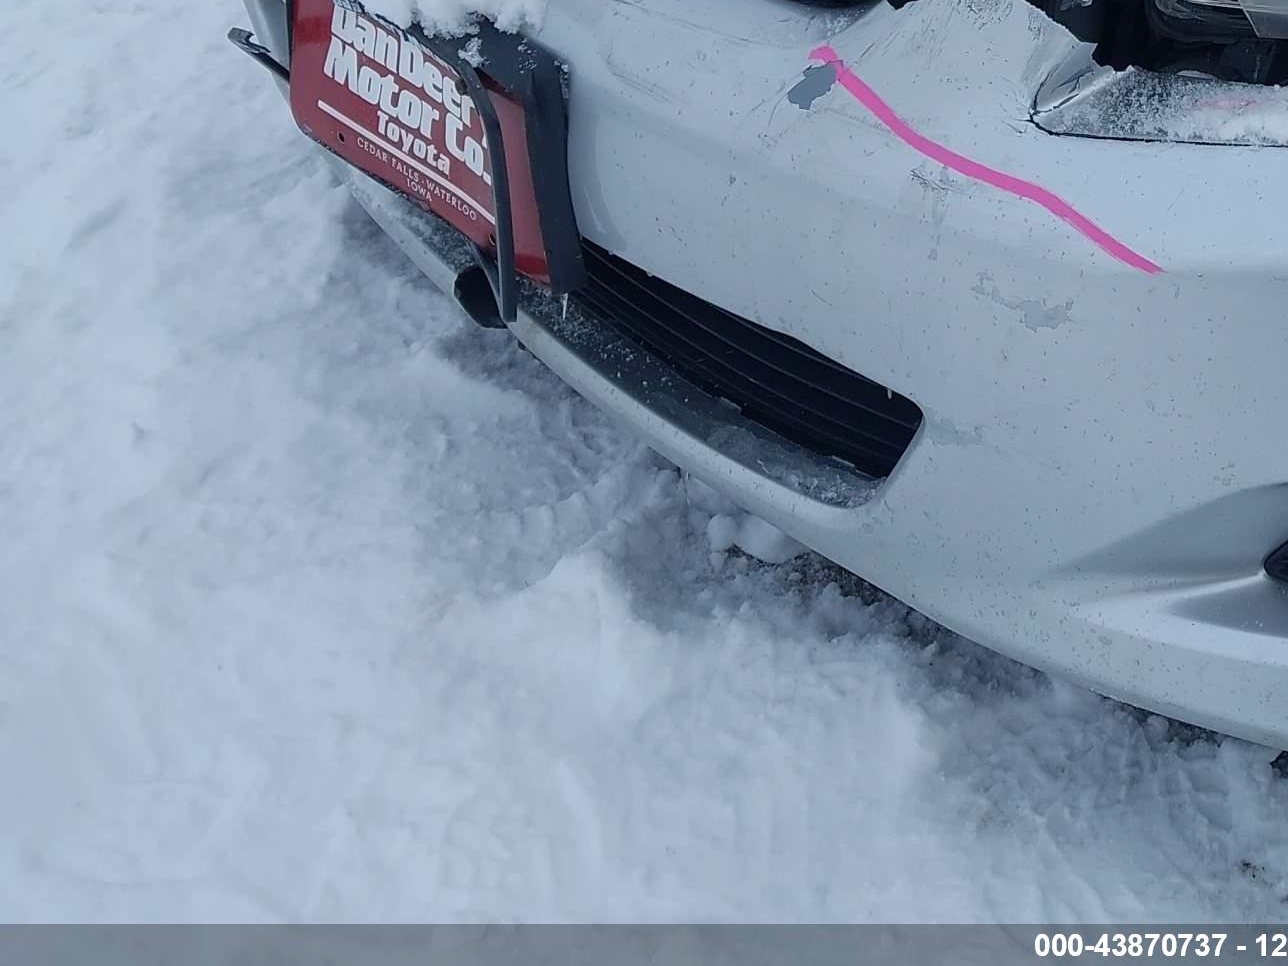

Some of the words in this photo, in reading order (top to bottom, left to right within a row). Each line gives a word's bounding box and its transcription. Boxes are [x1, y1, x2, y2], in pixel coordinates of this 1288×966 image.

[324, 35, 439, 140] Motor
[445, 113, 492, 186] Co.
[377, 110, 451, 177] Toyota
[357, 137, 387, 163] CEDAR
[391, 158, 420, 183] FALLS
[426, 180, 477, 221] WATERLOO
[407, 177, 433, 202] IOWA
